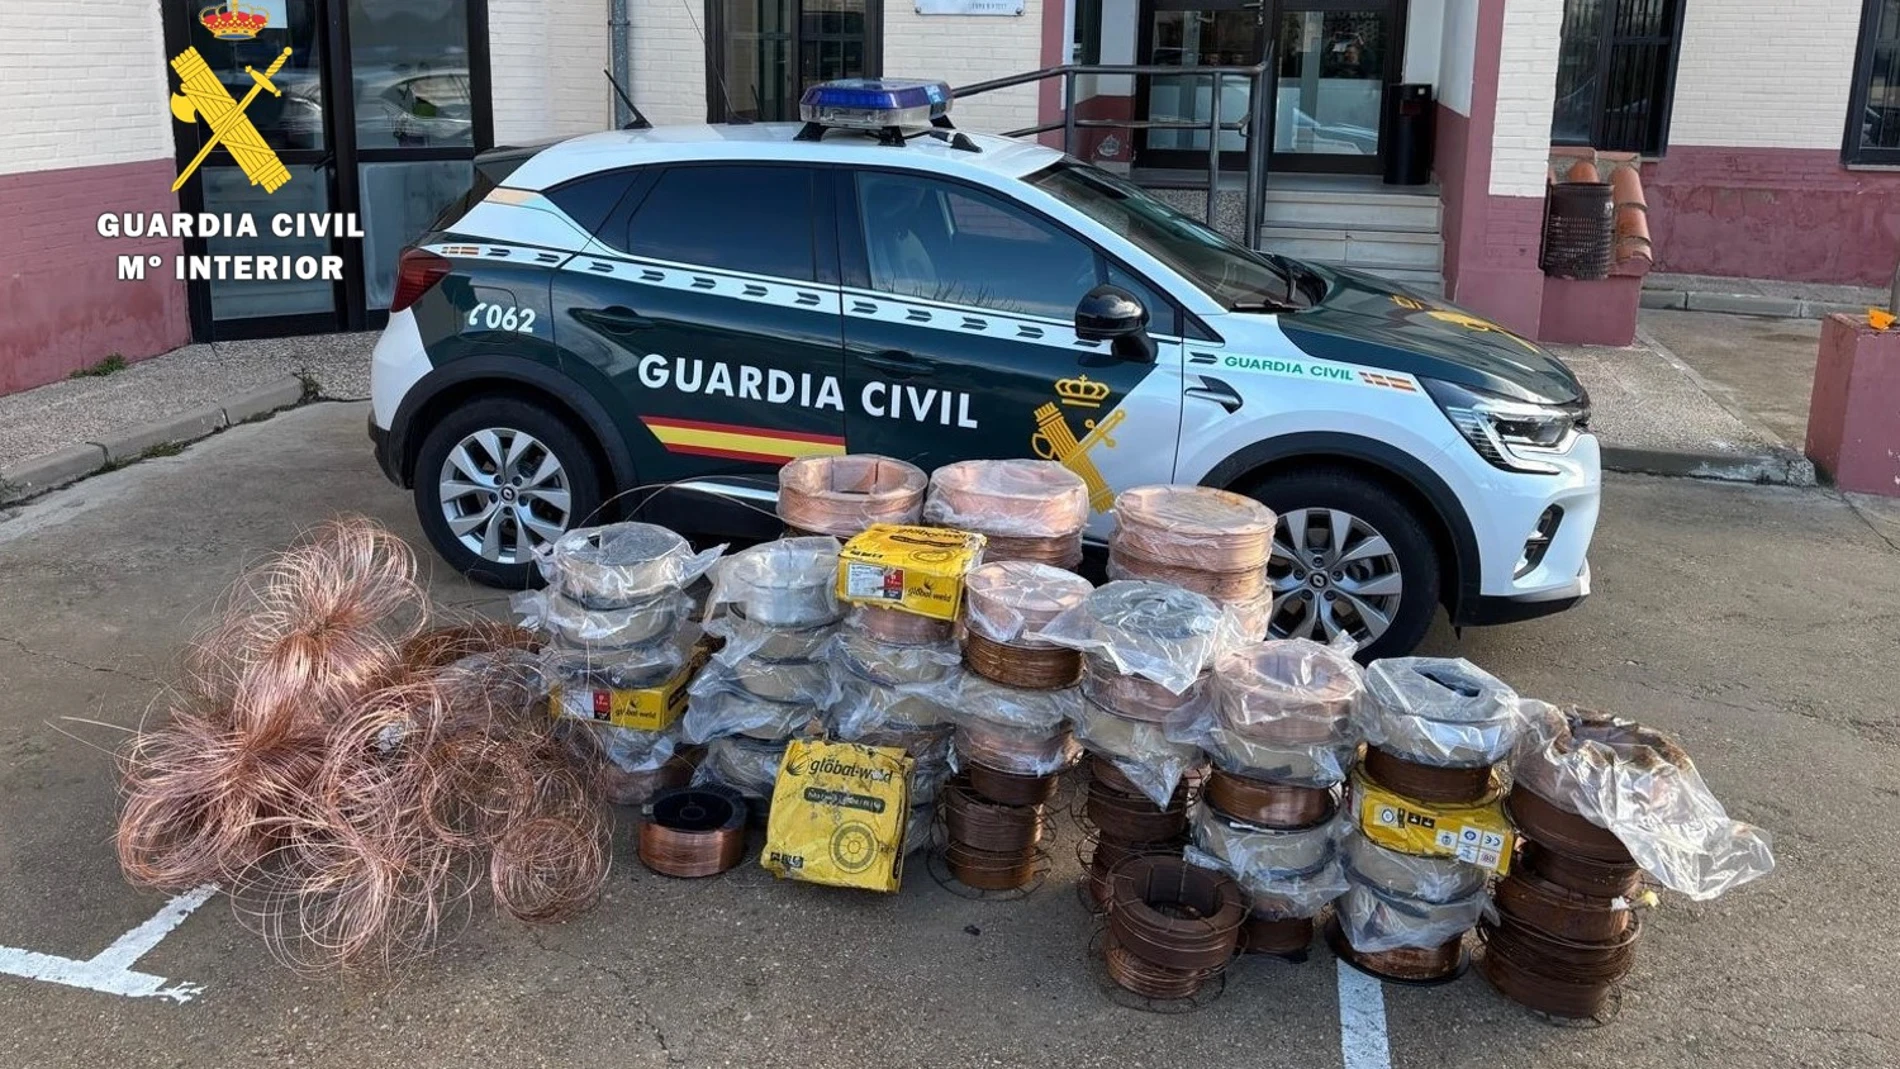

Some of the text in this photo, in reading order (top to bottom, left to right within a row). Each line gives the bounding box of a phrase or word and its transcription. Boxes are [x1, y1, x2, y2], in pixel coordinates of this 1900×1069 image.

[486, 304, 536, 333] 062
[1224, 356, 1354, 381] GUARDIA CIVIL
[638, 353, 979, 429] GUARDIA CIVIL
